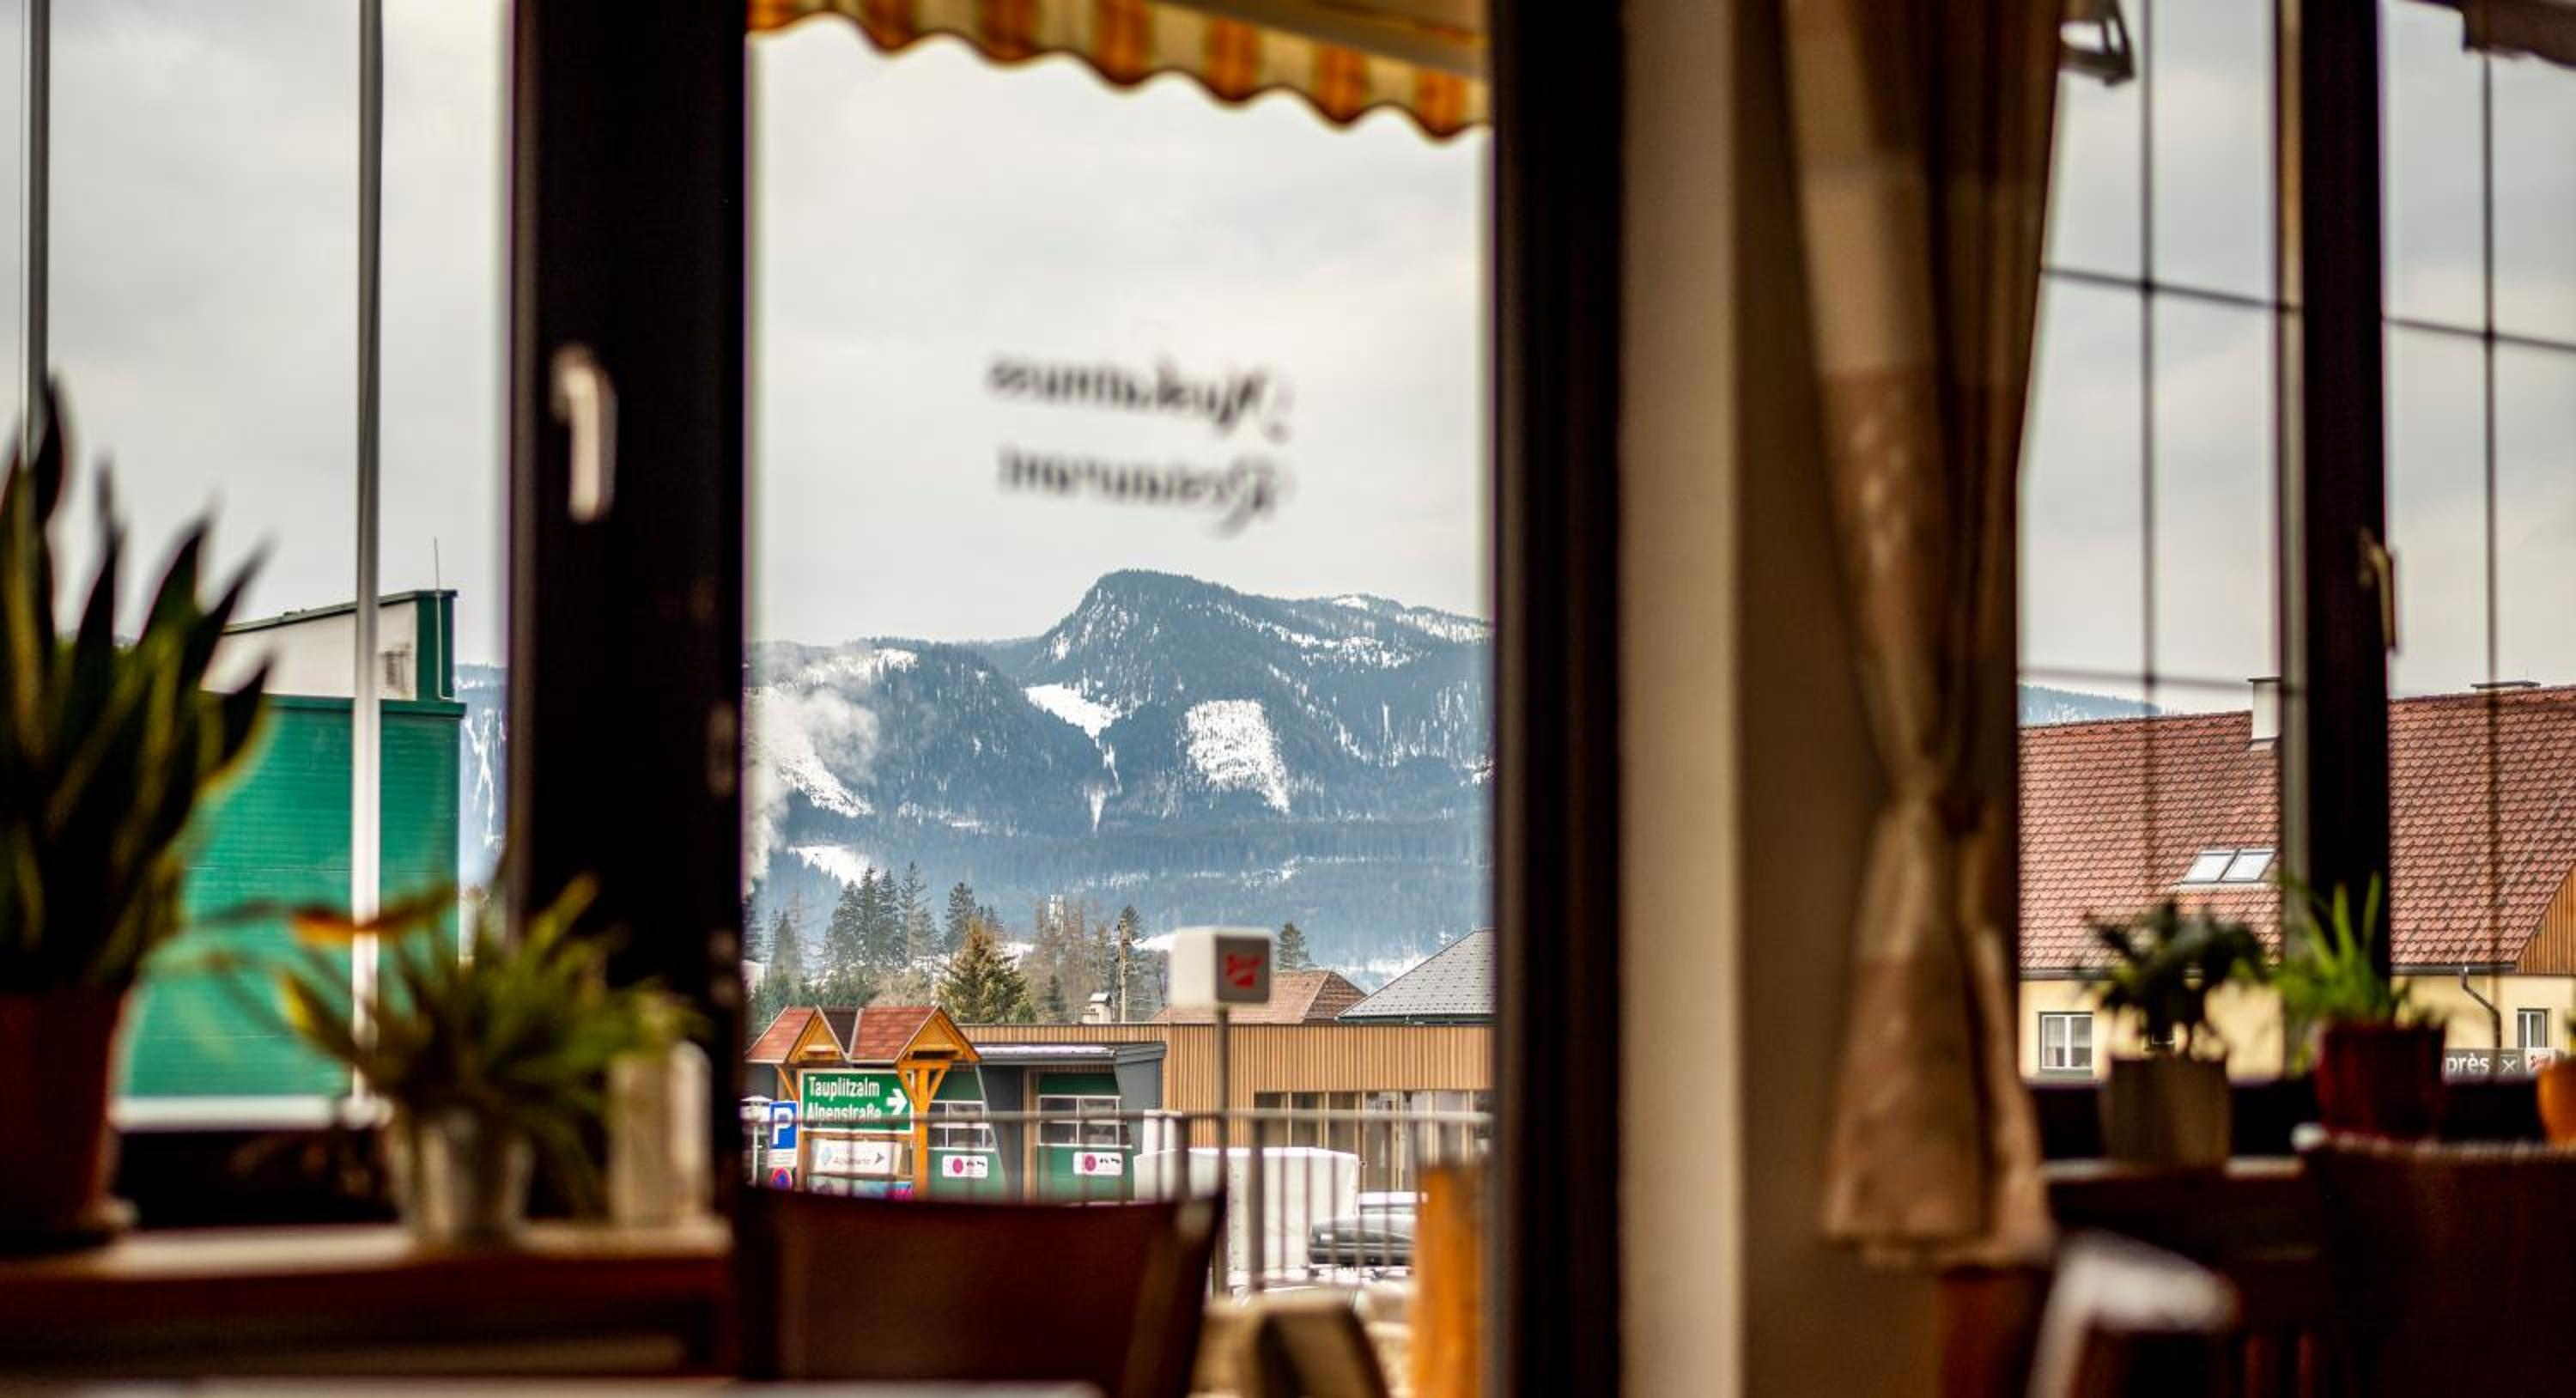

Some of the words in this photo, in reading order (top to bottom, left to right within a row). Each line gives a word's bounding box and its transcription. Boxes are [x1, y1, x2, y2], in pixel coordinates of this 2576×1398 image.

[2445, 1053, 2489, 1073] près
[808, 1076, 880, 1101] Tauplitzalm
[806, 1103, 882, 1124] Alpenstraße
[773, 1107, 793, 1144] P
